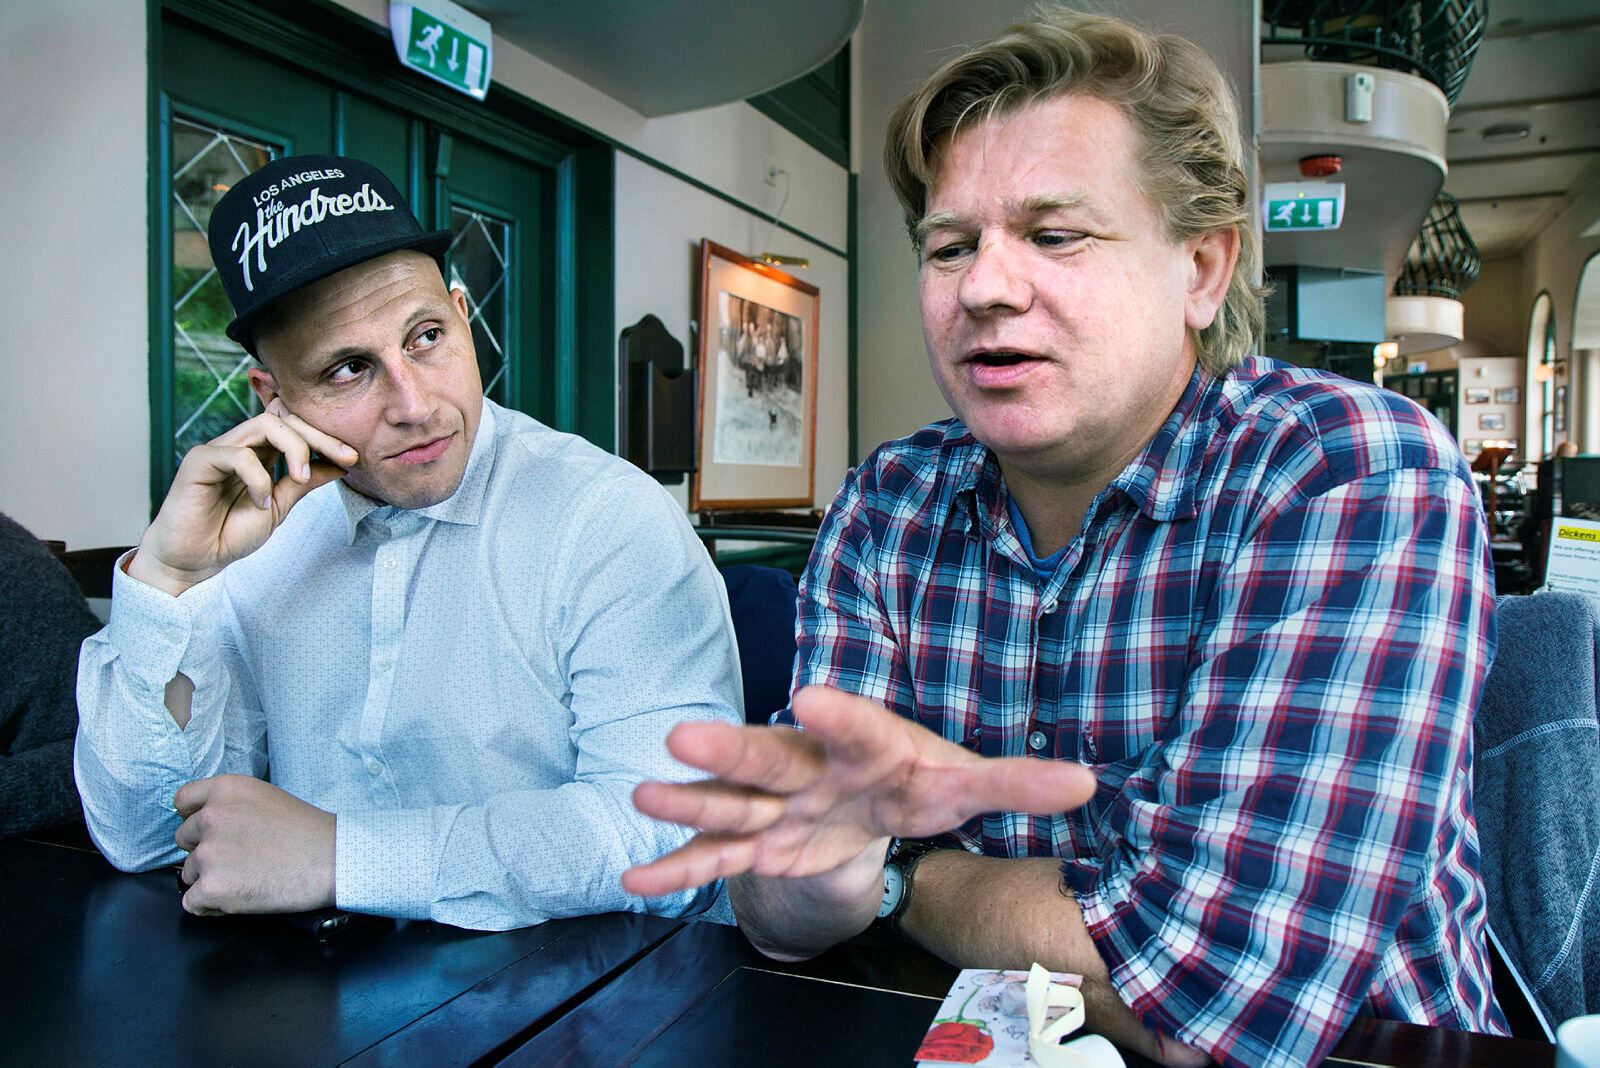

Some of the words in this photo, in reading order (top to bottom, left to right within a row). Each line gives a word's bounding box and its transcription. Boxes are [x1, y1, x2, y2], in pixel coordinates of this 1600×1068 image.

[253, 184, 279, 207] LOS
[281, 168, 345, 191] ANGELES
[264, 198, 284, 220] the
[231, 183, 395, 292] Hundreds
[1560, 528, 1597, 540] Dickens
